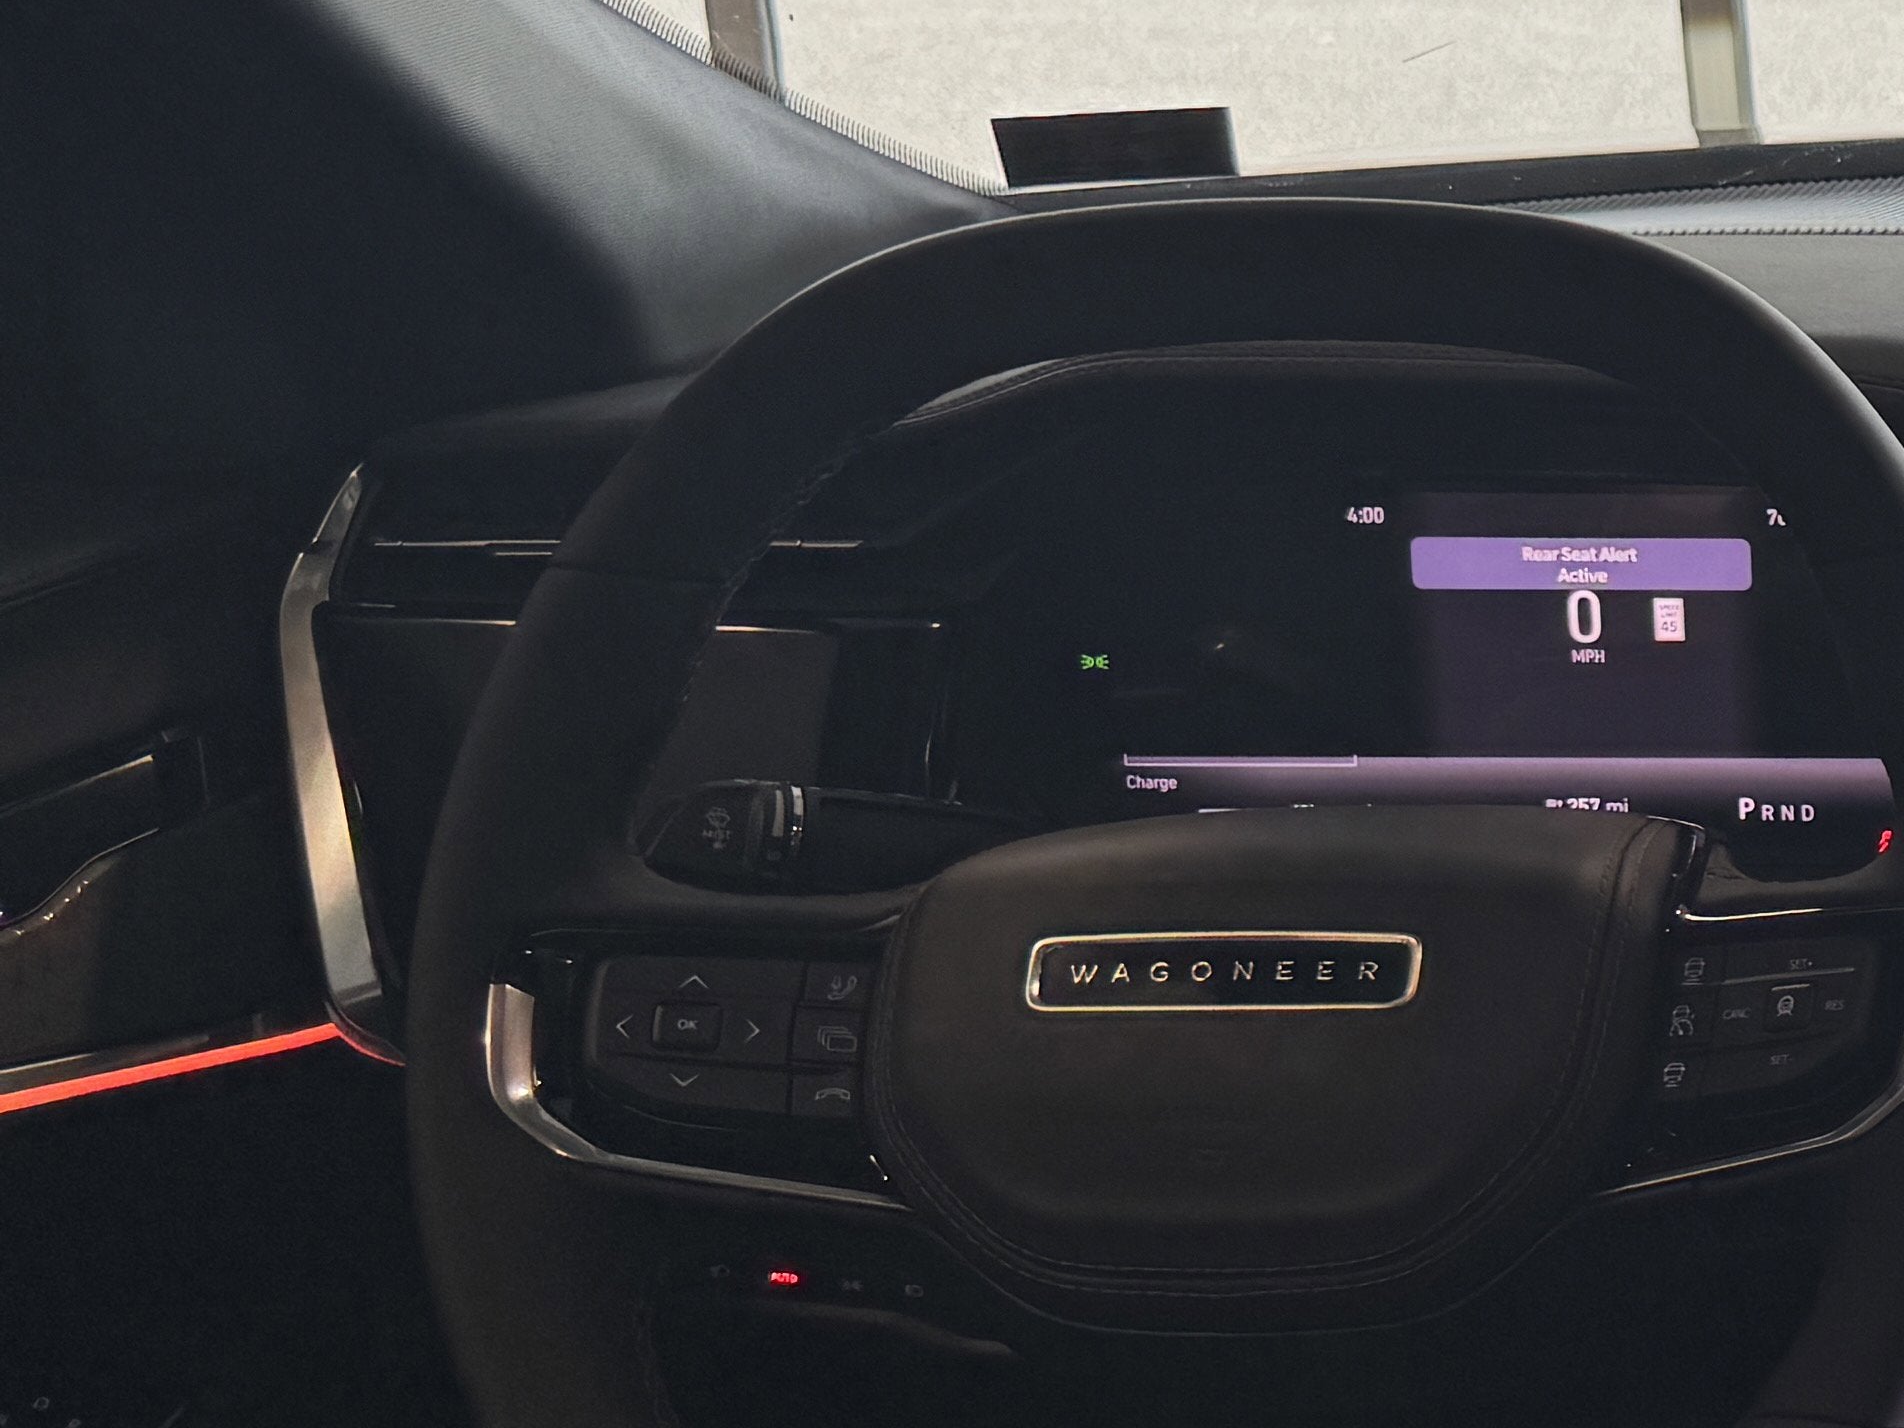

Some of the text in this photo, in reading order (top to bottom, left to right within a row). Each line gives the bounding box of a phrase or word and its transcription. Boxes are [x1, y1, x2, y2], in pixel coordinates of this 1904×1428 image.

[1346, 507, 1385, 525] 4:00
[1521, 546, 1638, 563] Rear Seat Alert
[1557, 567, 1608, 584] Active
[1566, 589, 1602, 644] 0
[1660, 621, 1678, 633] 45
[1572, 649, 1605, 664] MPH
[1126, 774, 1178, 792] Charge
[1605, 797, 1629, 813] mi
[1738, 797, 1816, 822] P R N D
[1070, 960, 1380, 985] WAGONEER
[676, 1018, 700, 1032] OK
[769, 1271, 799, 1285] AUTO
